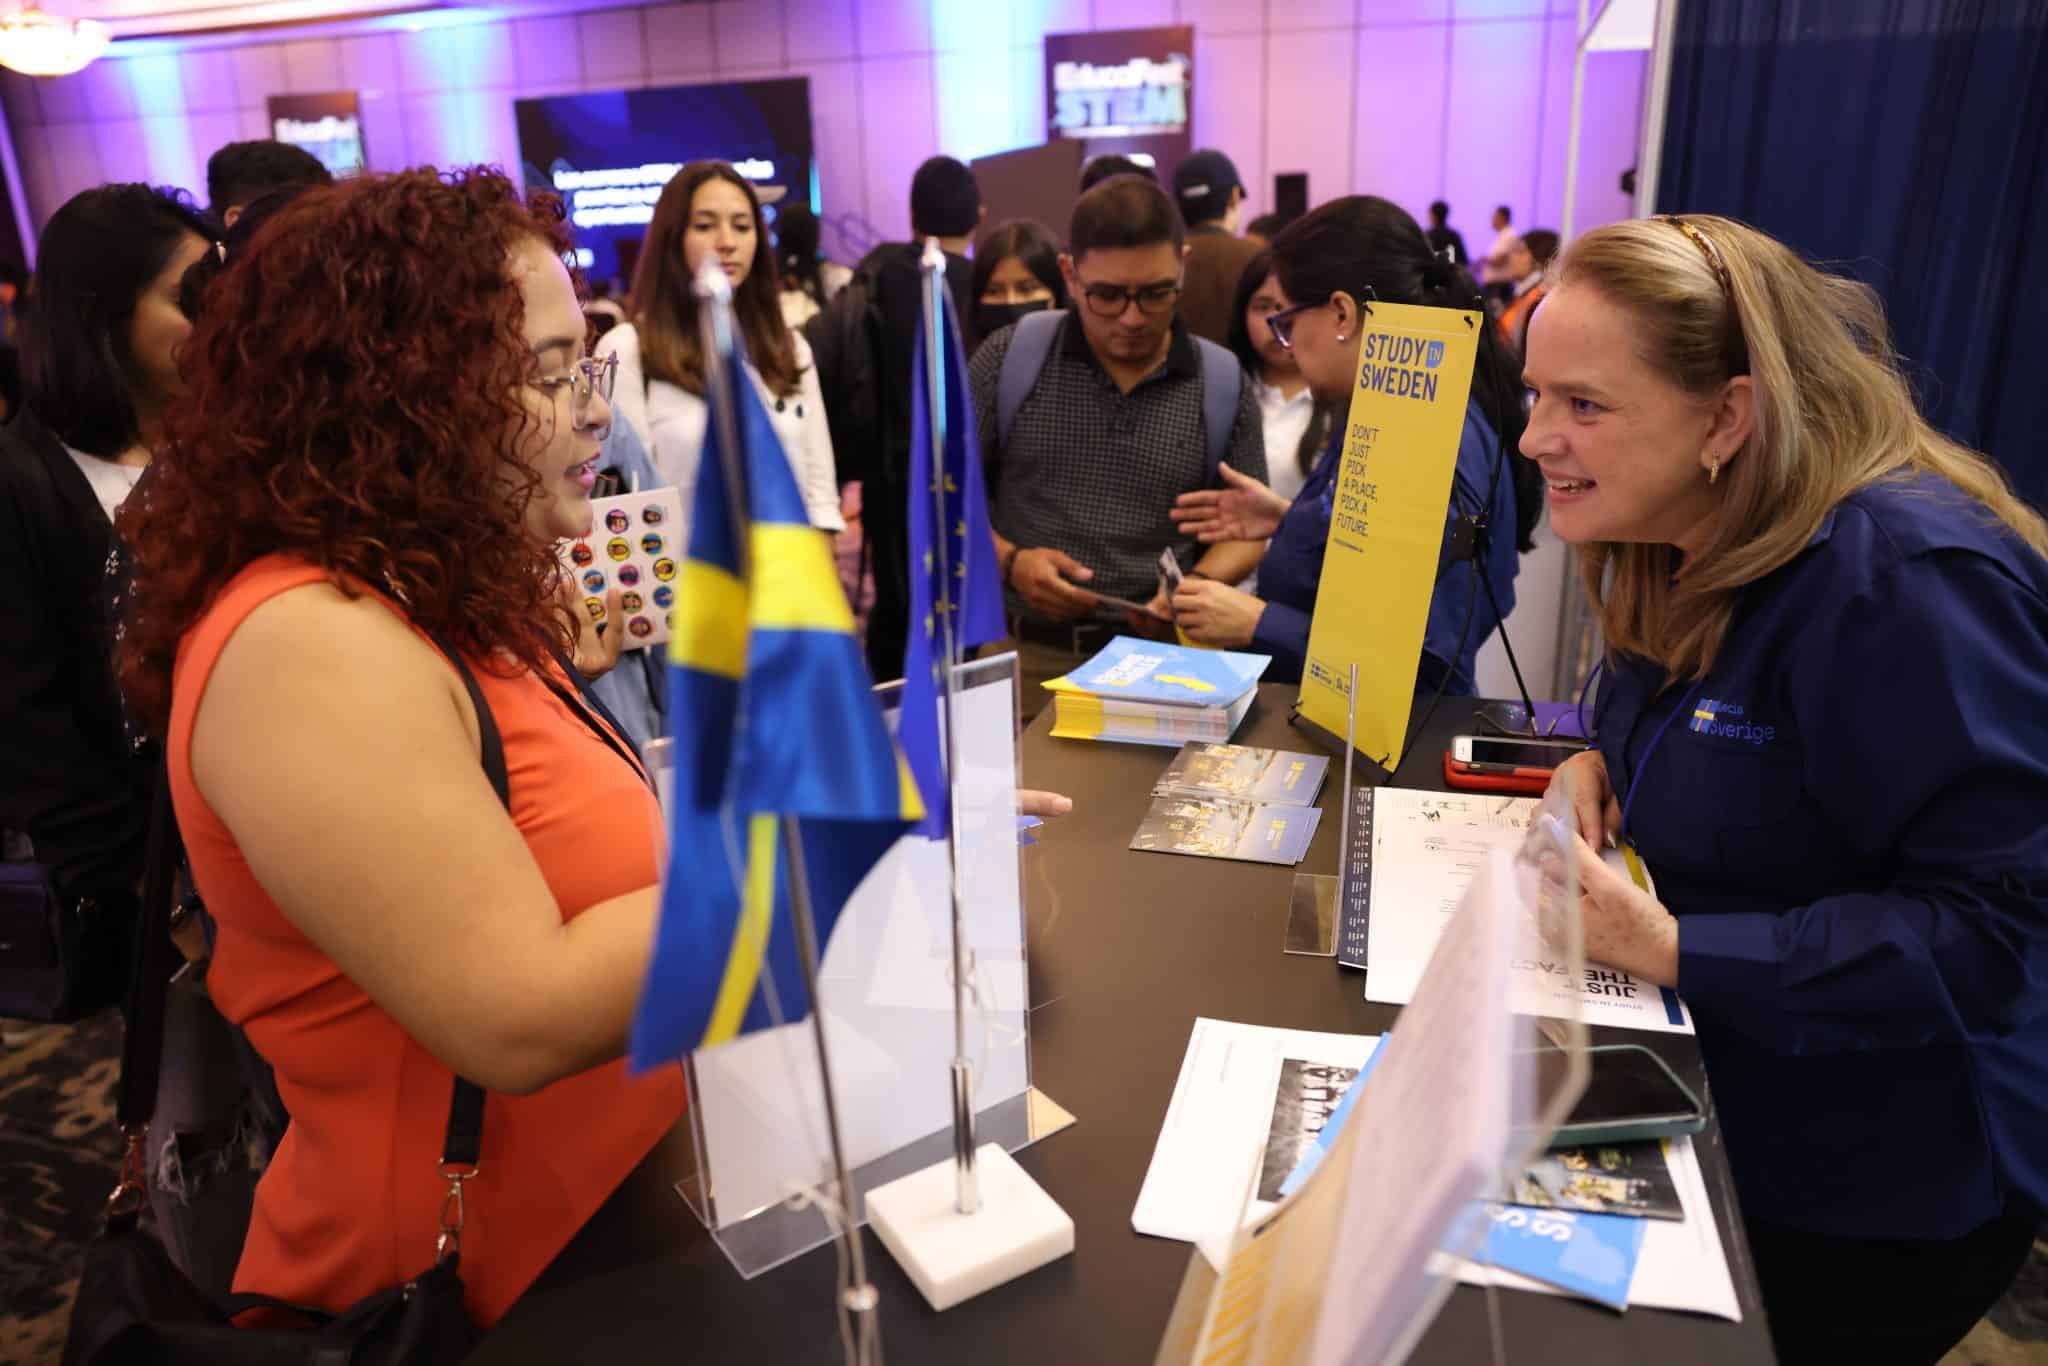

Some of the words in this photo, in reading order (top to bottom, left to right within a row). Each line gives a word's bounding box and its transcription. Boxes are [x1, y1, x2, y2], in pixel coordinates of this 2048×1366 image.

[1365, 333, 1426, 367] STUDY
[1360, 362, 1438, 402] SWEDEN
[1352, 423, 1379, 442] DON'T
[1349, 441, 1371, 459] JUST
[1346, 459, 1368, 478] PICK
[1340, 493, 1360, 512] PICK
[1361, 500, 1369, 516] A
[1711, 718, 1776, 745] Sverige
[1584, 968, 1638, 986] THE
[1561, 978, 1638, 999] JUST
